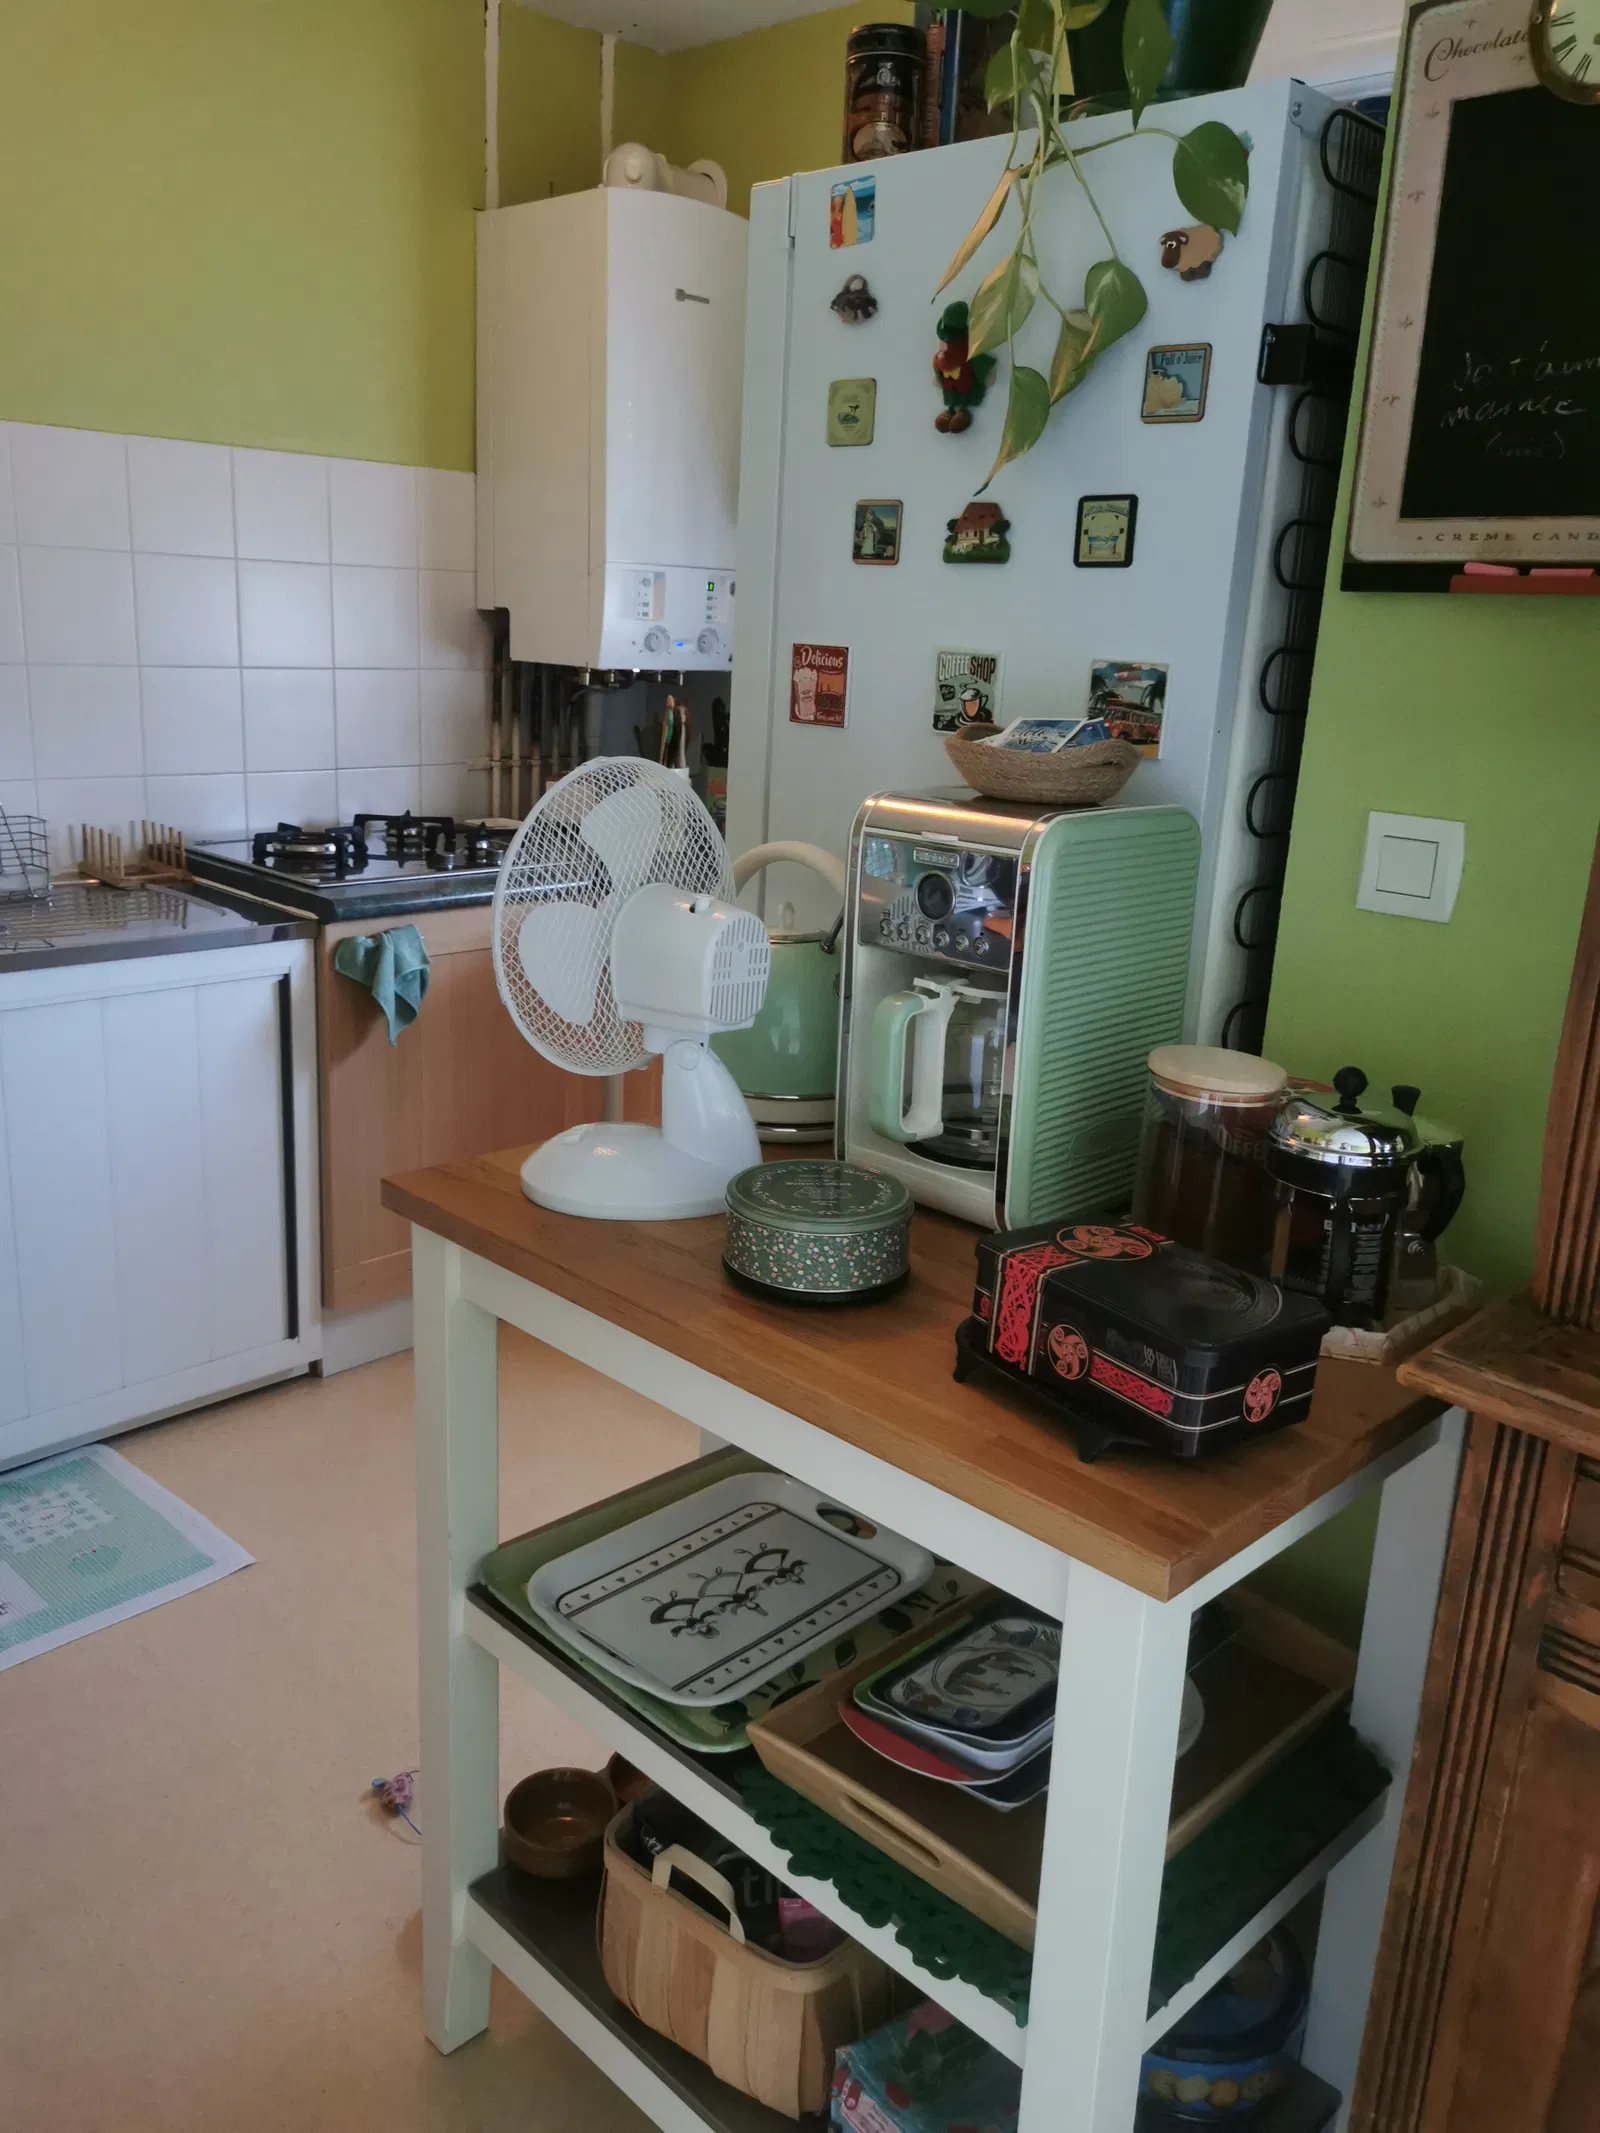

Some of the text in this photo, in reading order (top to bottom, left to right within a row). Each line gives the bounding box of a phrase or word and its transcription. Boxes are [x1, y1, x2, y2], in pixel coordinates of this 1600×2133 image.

[1435, 532, 1517, 542] CREME
[800, 646, 843, 669] Delicious
[938, 654, 996, 684] COFFEE SHOP
